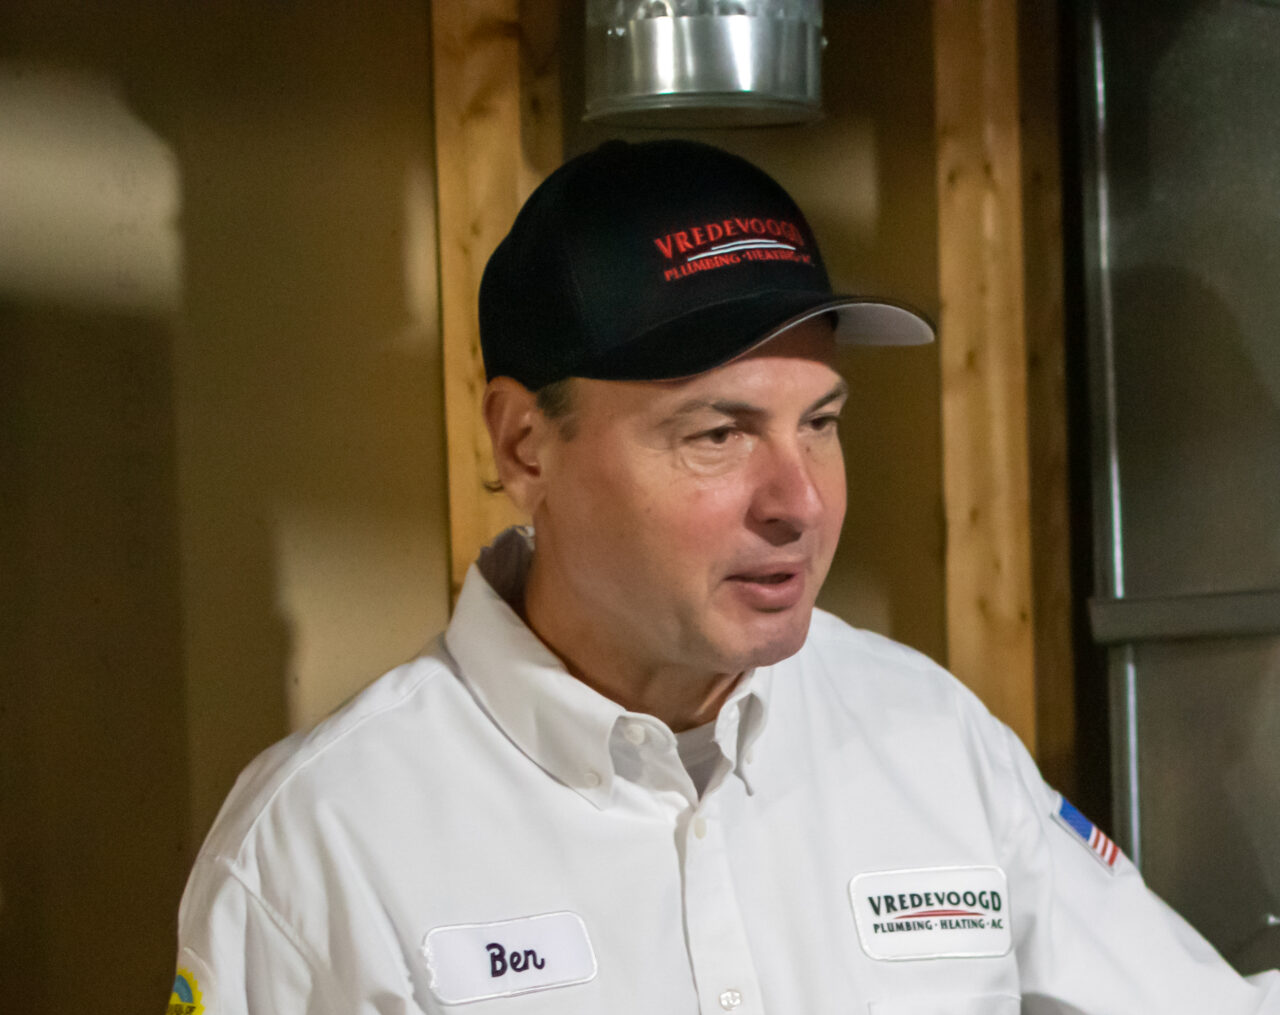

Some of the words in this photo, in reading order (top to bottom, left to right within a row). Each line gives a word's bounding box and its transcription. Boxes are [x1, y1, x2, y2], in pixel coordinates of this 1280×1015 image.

[664, 253, 741, 281] PLUMBING
[868, 891, 1002, 916] VREDEVOOGD
[873, 920, 933, 934] PLUMBING
[940, 919, 985, 930] HEATING
[990, 918, 1003, 929] AC
[485, 942, 545, 978] Ben
